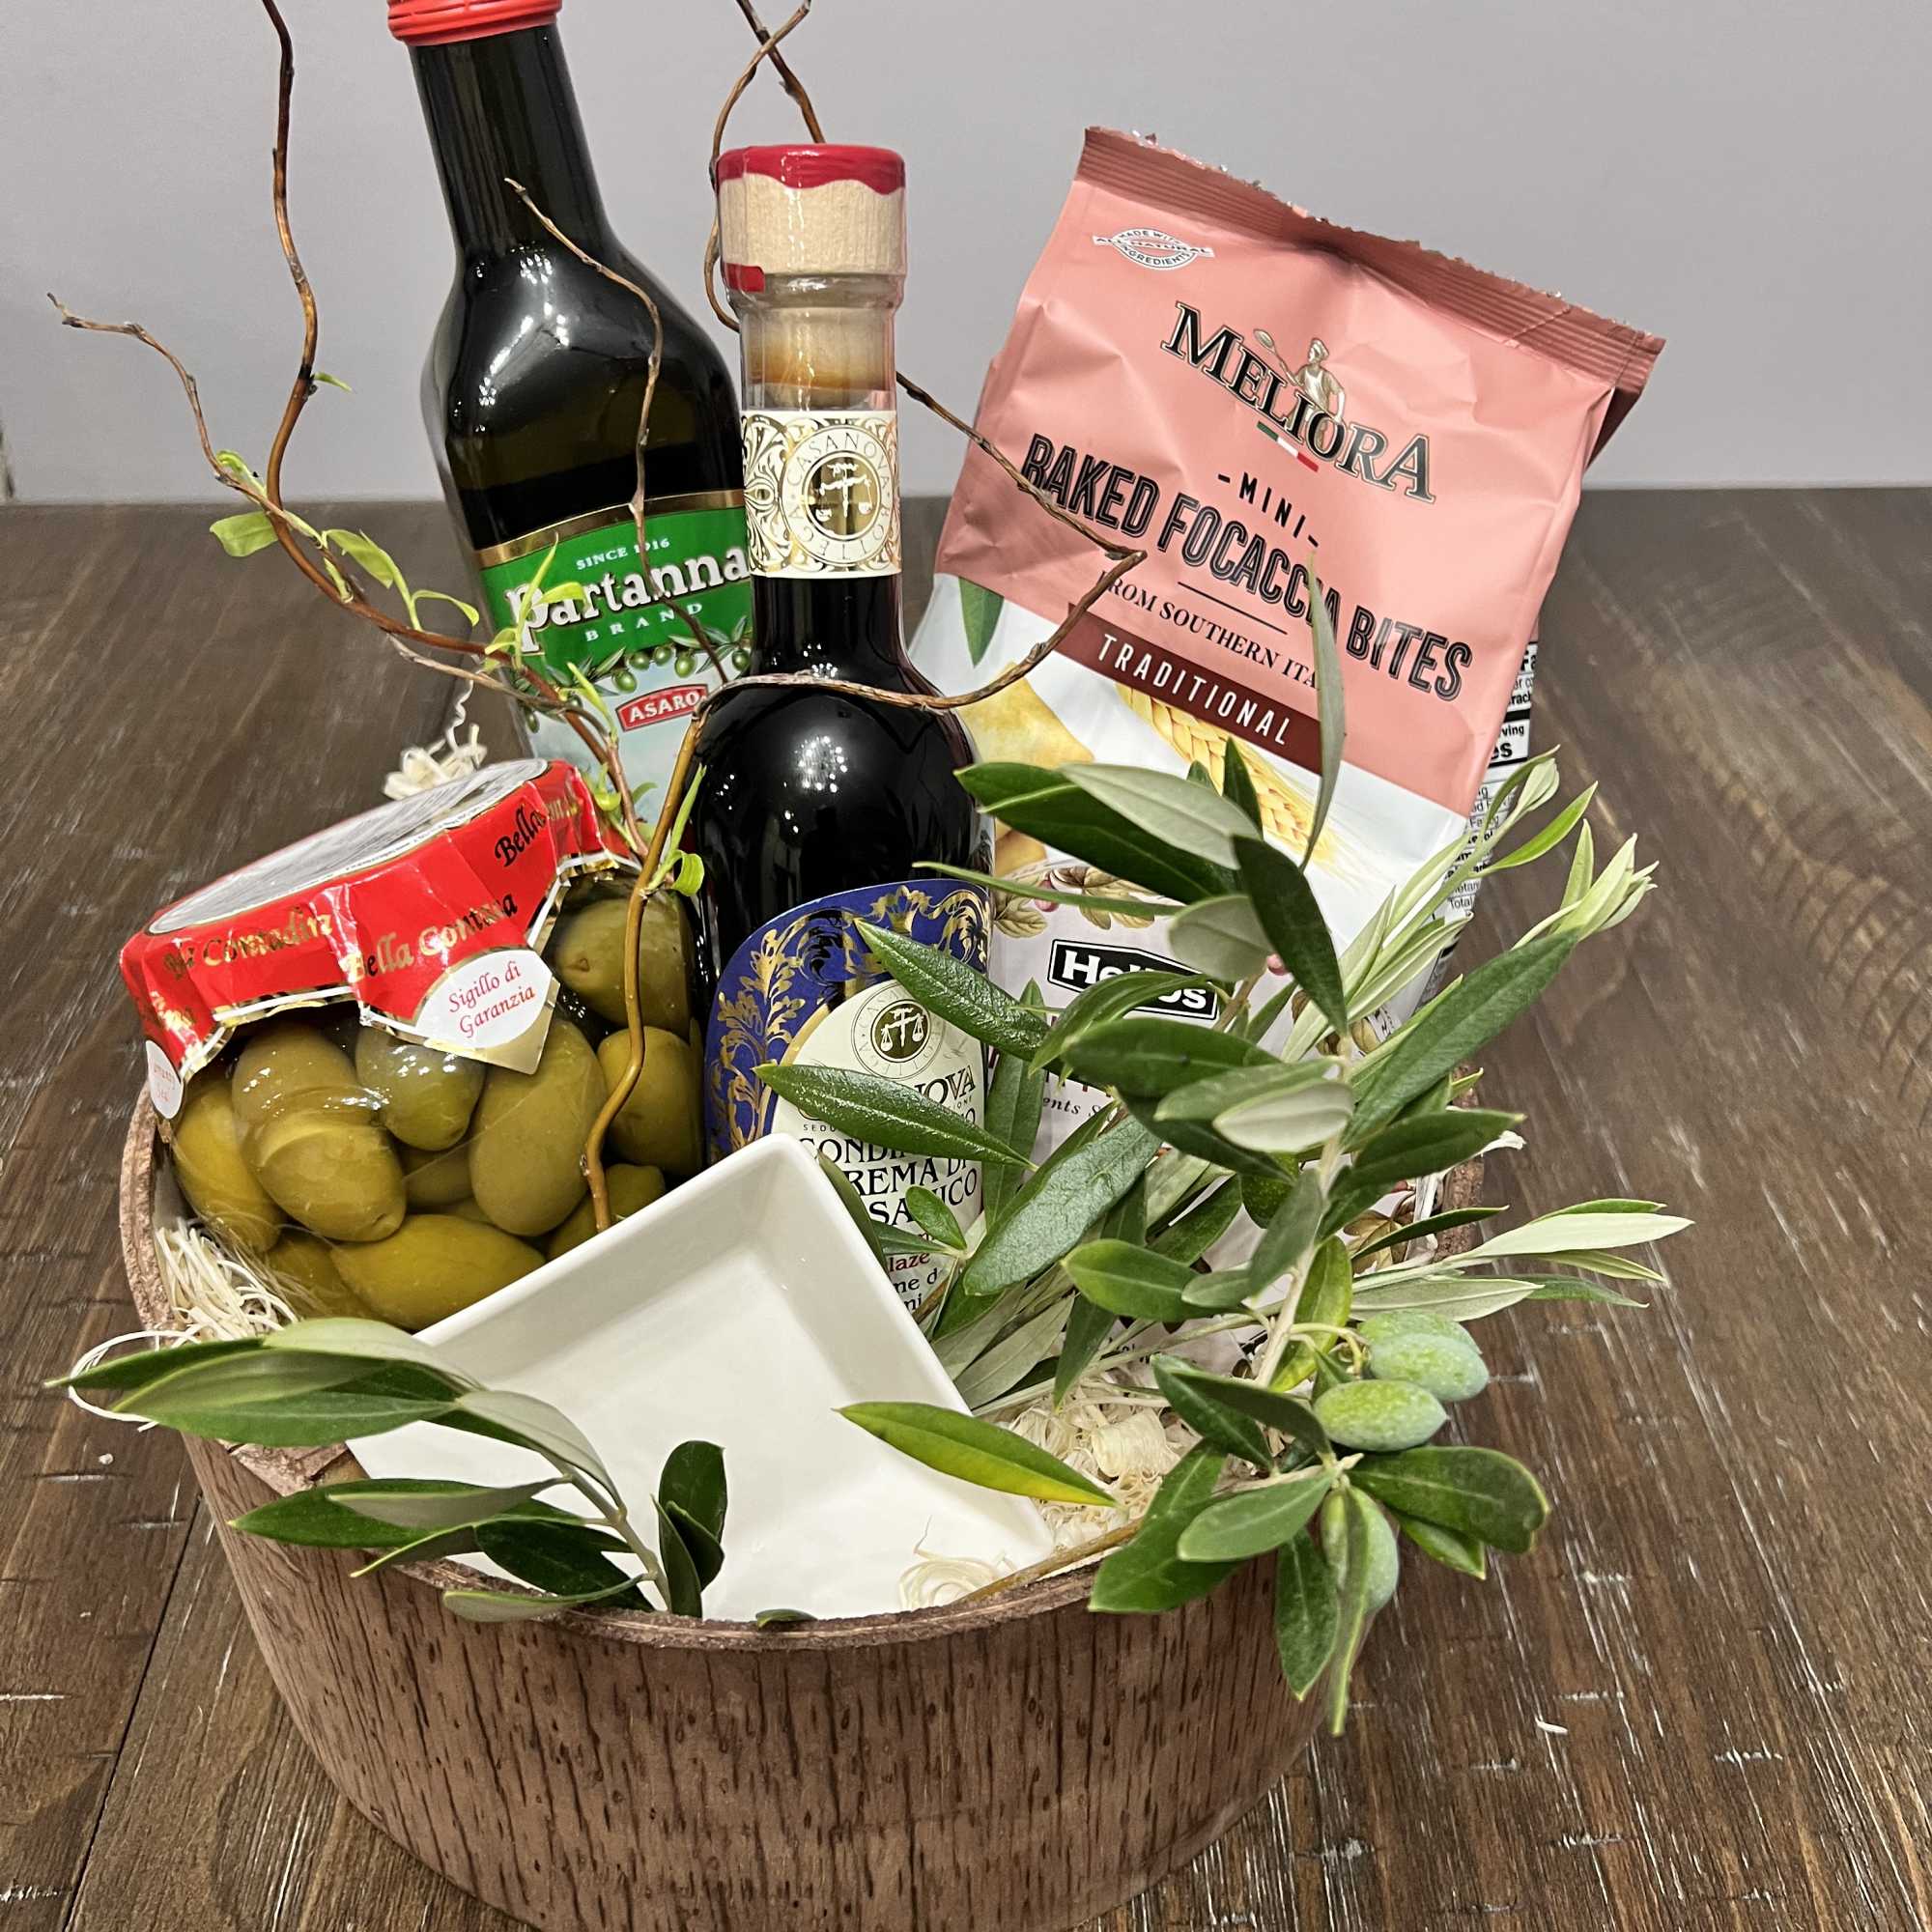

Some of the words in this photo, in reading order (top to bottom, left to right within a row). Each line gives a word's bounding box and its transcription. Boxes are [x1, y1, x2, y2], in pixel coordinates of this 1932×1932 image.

[1160, 299, 1436, 504] MELIORA
[576, 547, 628, 571] SINCE
[1020, 433, 1160, 538] BAKED
[1347, 605, 1473, 701] BITES
[585, 603, 702, 641] BRAND
[1100, 571, 1157, 612] ROM
[1159, 601, 1282, 668] SOUTHERN
[1282, 658, 1320, 690] ITA
[629, 691, 700, 724] ASARO
[1098, 633, 1291, 745] TRADITIONAL
[448, 971, 500, 1013] Sigillo
[504, 960, 522, 984] di
[459, 985, 536, 1038] Garanzia
[890, 1252, 930, 1273] laze
